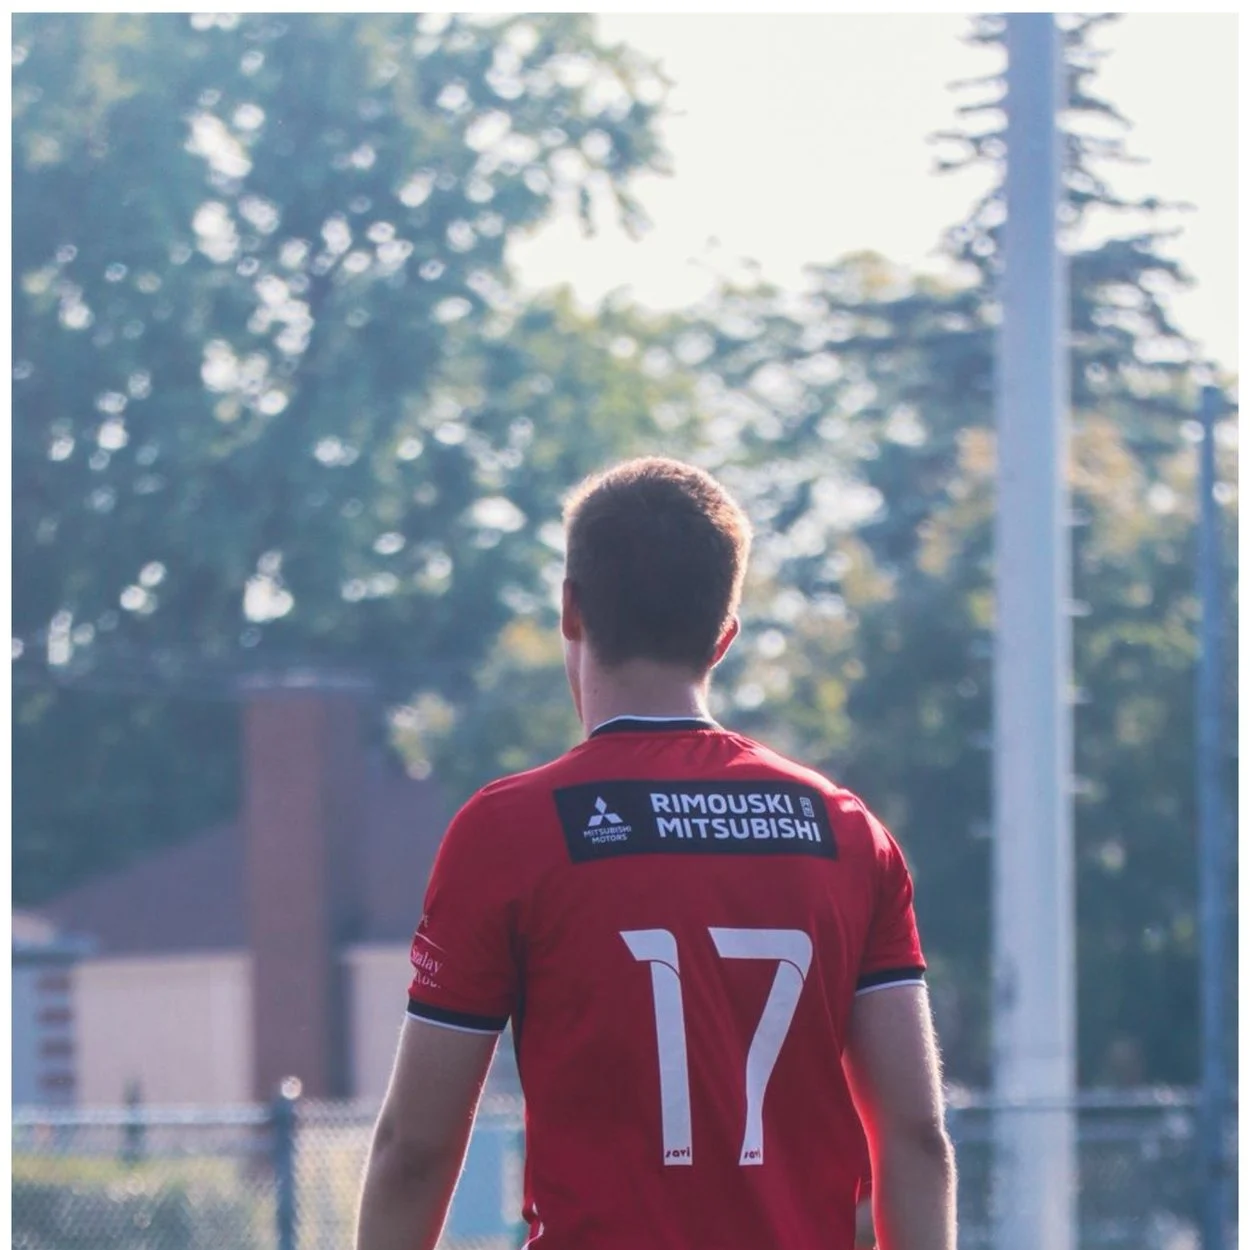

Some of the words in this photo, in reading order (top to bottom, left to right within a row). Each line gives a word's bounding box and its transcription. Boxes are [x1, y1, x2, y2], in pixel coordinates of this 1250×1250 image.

[650, 792, 795, 815] RIMOUSKI
[583, 825, 632, 838] MITSUBISHI
[591, 834, 628, 845] MOTORS
[656, 816, 822, 843] MITSUBISHI
[619, 926, 814, 1166] 17
